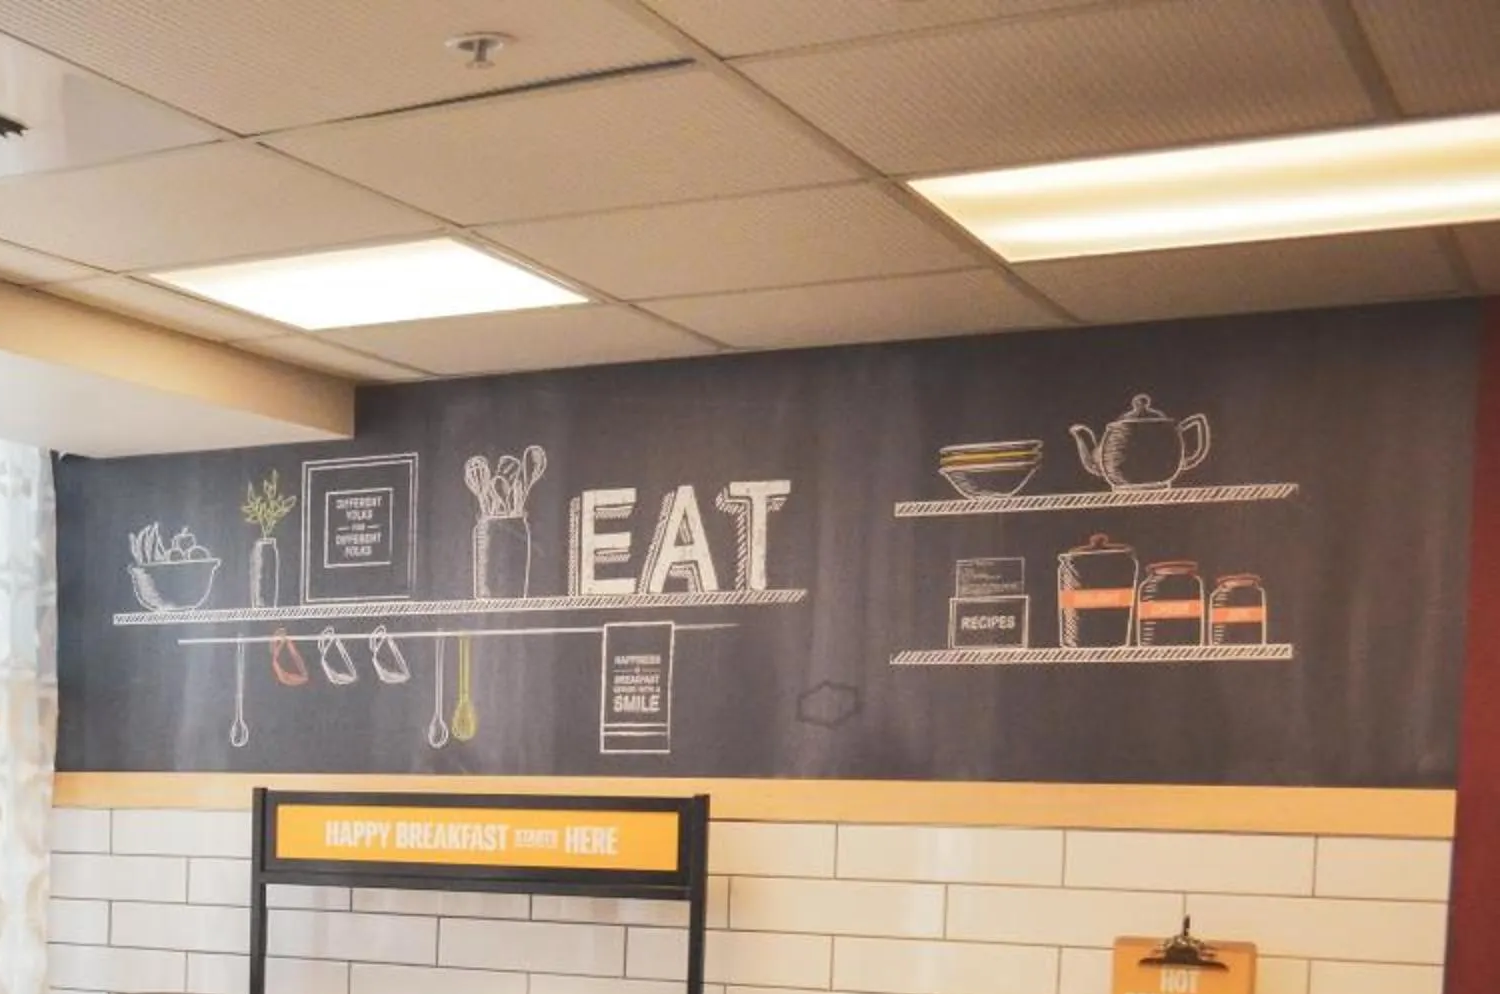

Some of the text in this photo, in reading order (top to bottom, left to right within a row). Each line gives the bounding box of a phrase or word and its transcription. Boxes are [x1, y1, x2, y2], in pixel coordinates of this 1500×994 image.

[570, 479, 791, 596] EAT
[961, 615, 1016, 630] RECIPES
[613, 695, 661, 713] SMILE
[325, 820, 390, 848] HAPPY
[395, 820, 509, 852] BREAKFAST
[564, 825, 619, 856] HERE
[1161, 967, 1199, 994] HOT
